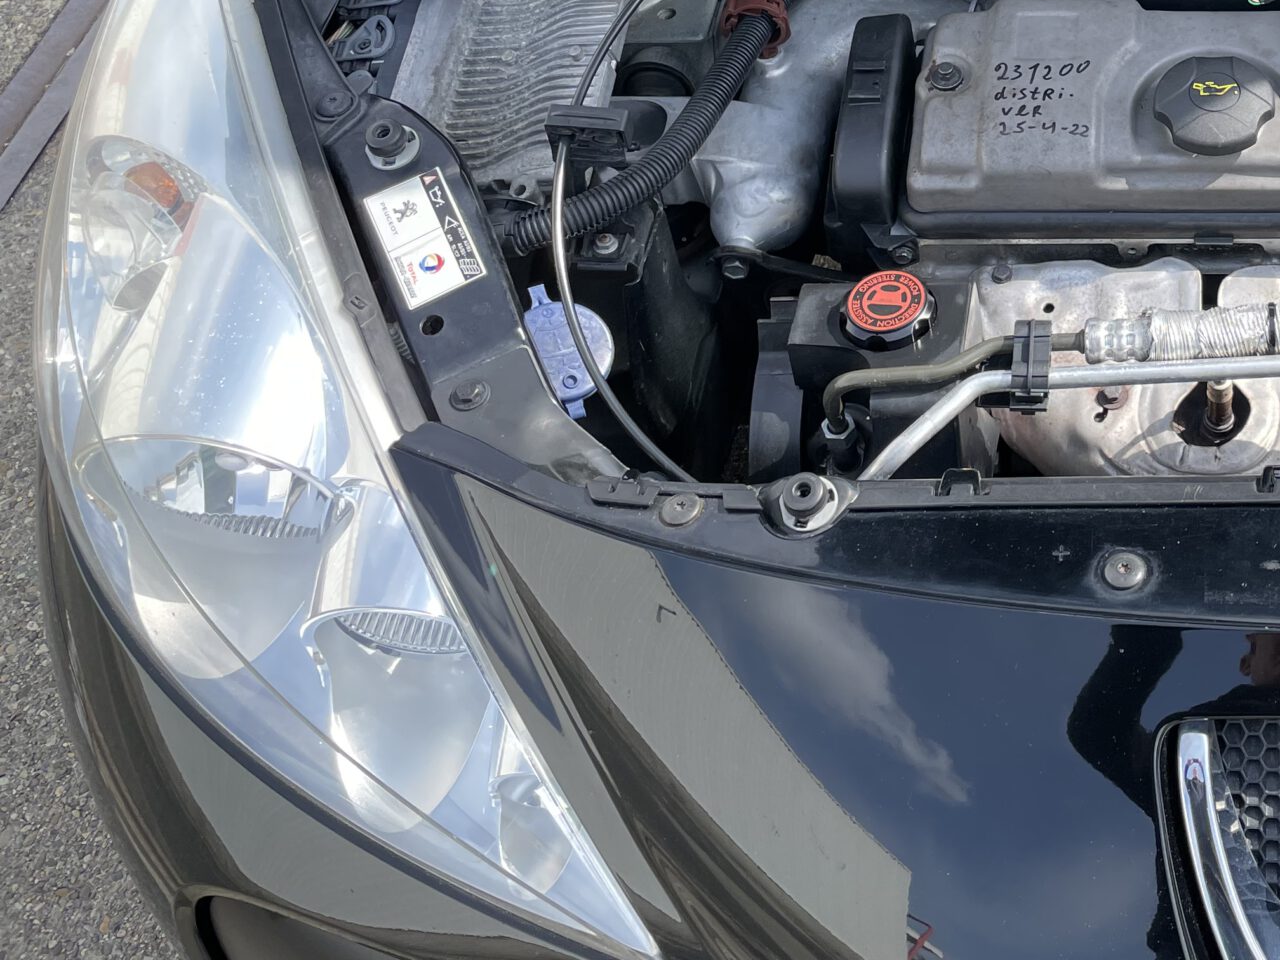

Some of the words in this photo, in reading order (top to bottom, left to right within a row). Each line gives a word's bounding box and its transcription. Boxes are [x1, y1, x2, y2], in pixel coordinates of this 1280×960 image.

[993, 59, 1091, 85] 231200
[379, 201, 399, 236] PEUGEOT
[405, 261, 418, 285] TOTAL
[858, 274, 896, 292] STEERING
[899, 275, 920, 295] POWER
[876, 303, 918, 327] DIRECTION
